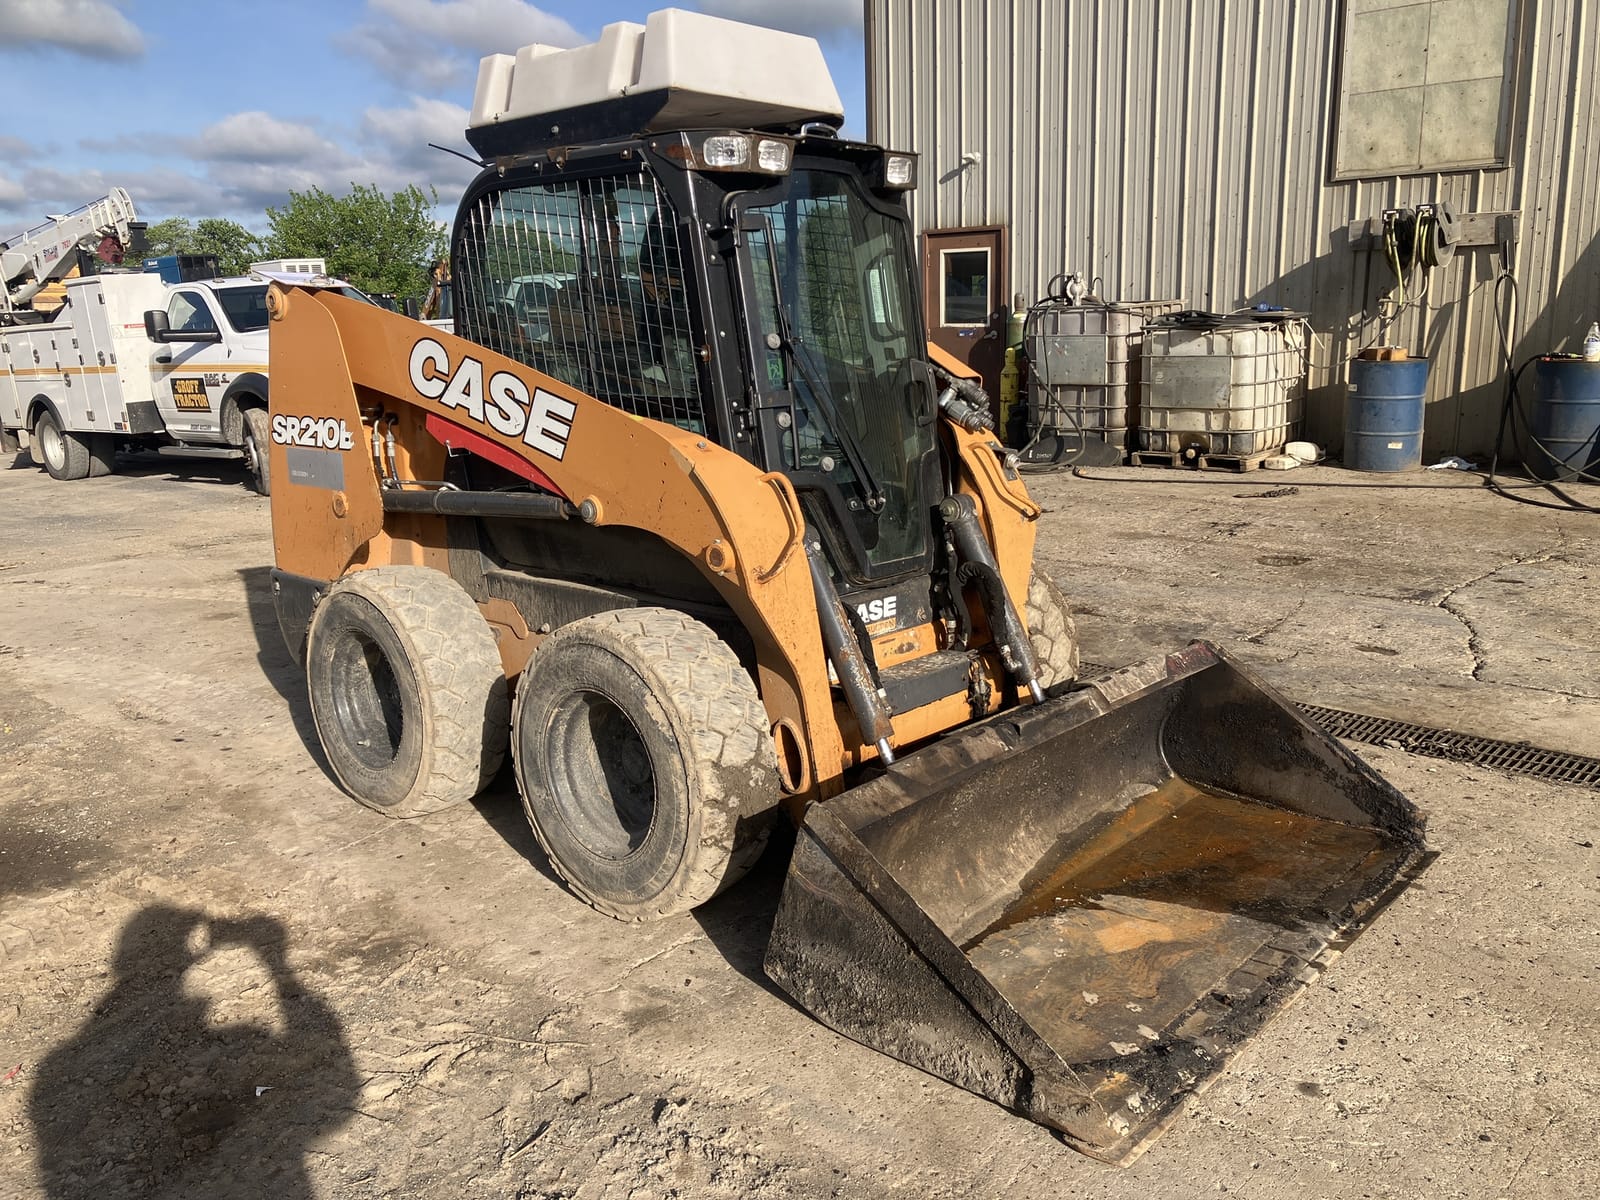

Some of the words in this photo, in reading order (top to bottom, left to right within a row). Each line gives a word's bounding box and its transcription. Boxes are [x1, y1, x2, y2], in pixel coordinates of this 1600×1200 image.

[175, 380, 199, 393] GROFF
[173, 393, 209, 408] TRACTOR
[408, 337, 578, 462] CASE
[857, 596, 897, 623] ASE
